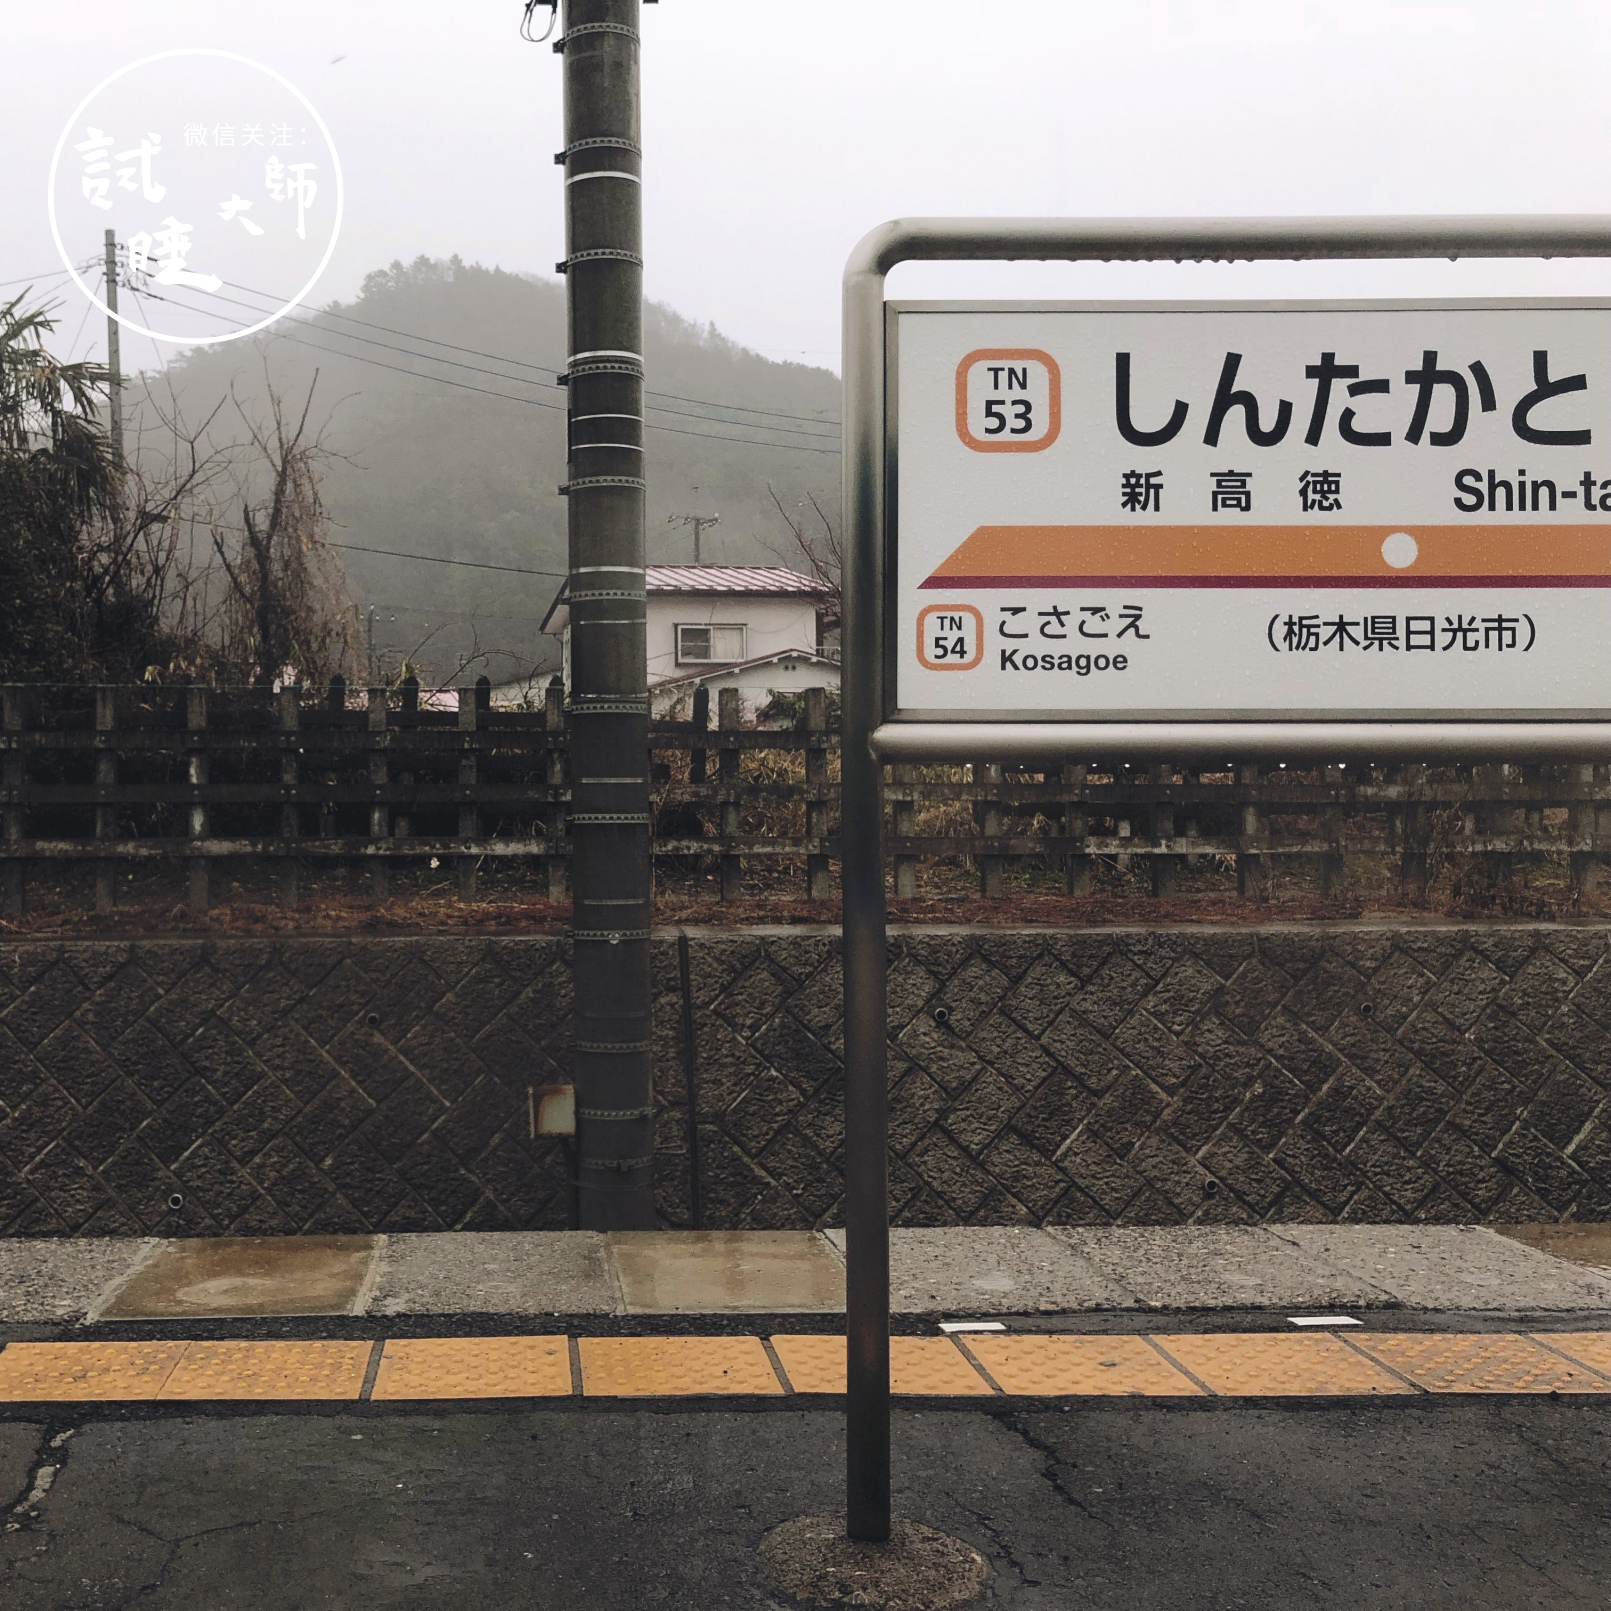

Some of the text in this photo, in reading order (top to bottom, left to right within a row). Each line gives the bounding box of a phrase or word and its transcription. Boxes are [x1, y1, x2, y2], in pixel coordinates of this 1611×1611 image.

[986, 367, 1028, 391] TN
[1115, 349, 1592, 448] しんたかと
[983, 399, 1034, 436] 53
[936, 615, 963, 632] TN
[998, 604, 1151, 640] こさごえ
[933, 636, 968, 660] 54
[1000, 648, 1129, 677] Kosagoe
